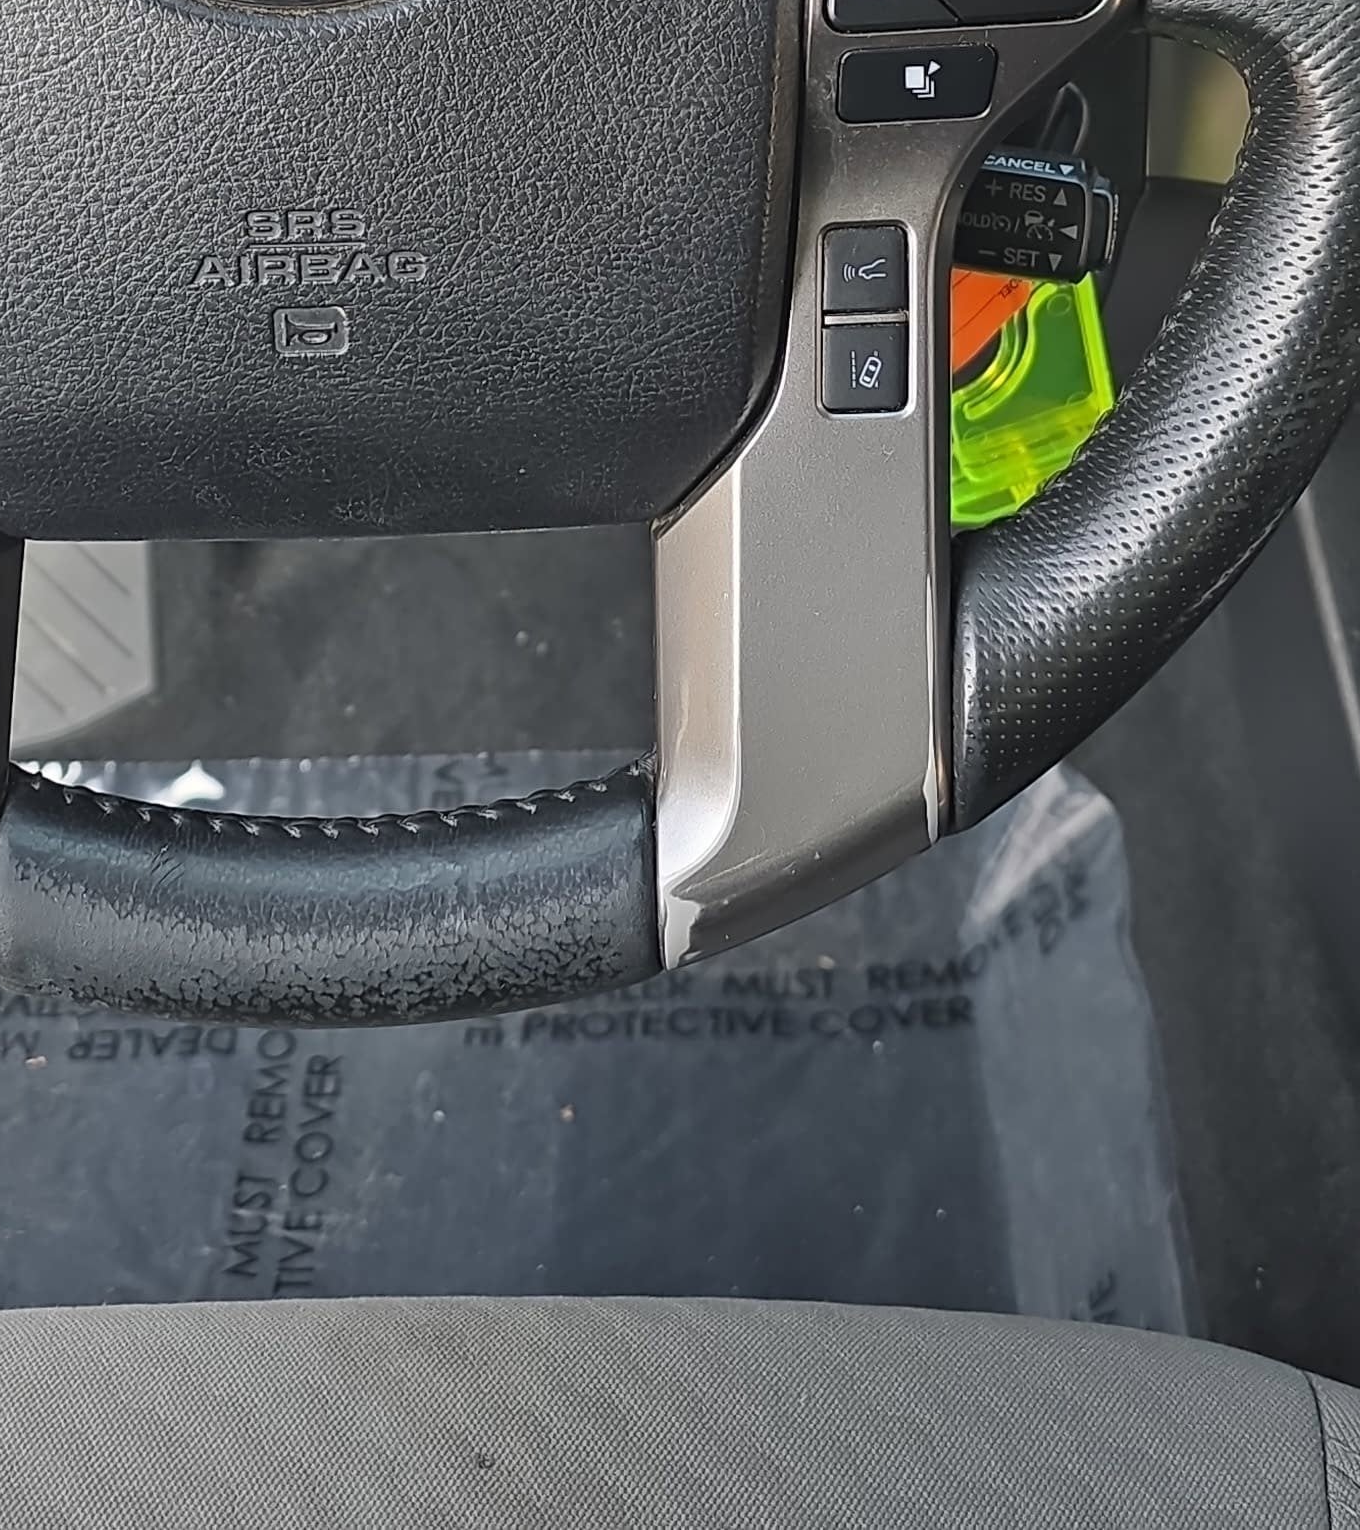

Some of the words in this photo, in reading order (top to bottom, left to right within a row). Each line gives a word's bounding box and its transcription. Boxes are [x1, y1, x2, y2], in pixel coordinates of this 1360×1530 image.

[1010, 182, 1047, 203] RES
[246, 210, 366, 239] SRS
[958, 212, 990, 229] OLD
[192, 251, 427, 286] AIRBAG
[1003, 245, 1040, 267] SET
[724, 967, 837, 1000] MUST
[520, 1004, 798, 1047] PROTECTIVE
[810, 997, 975, 1033] COVER
[67, 1026, 238, 1063] DEALER
[243, 1029, 297, 1144] REMO
[290, 1054, 344, 1201] COVER
[225, 1175, 277, 1278] MUST
